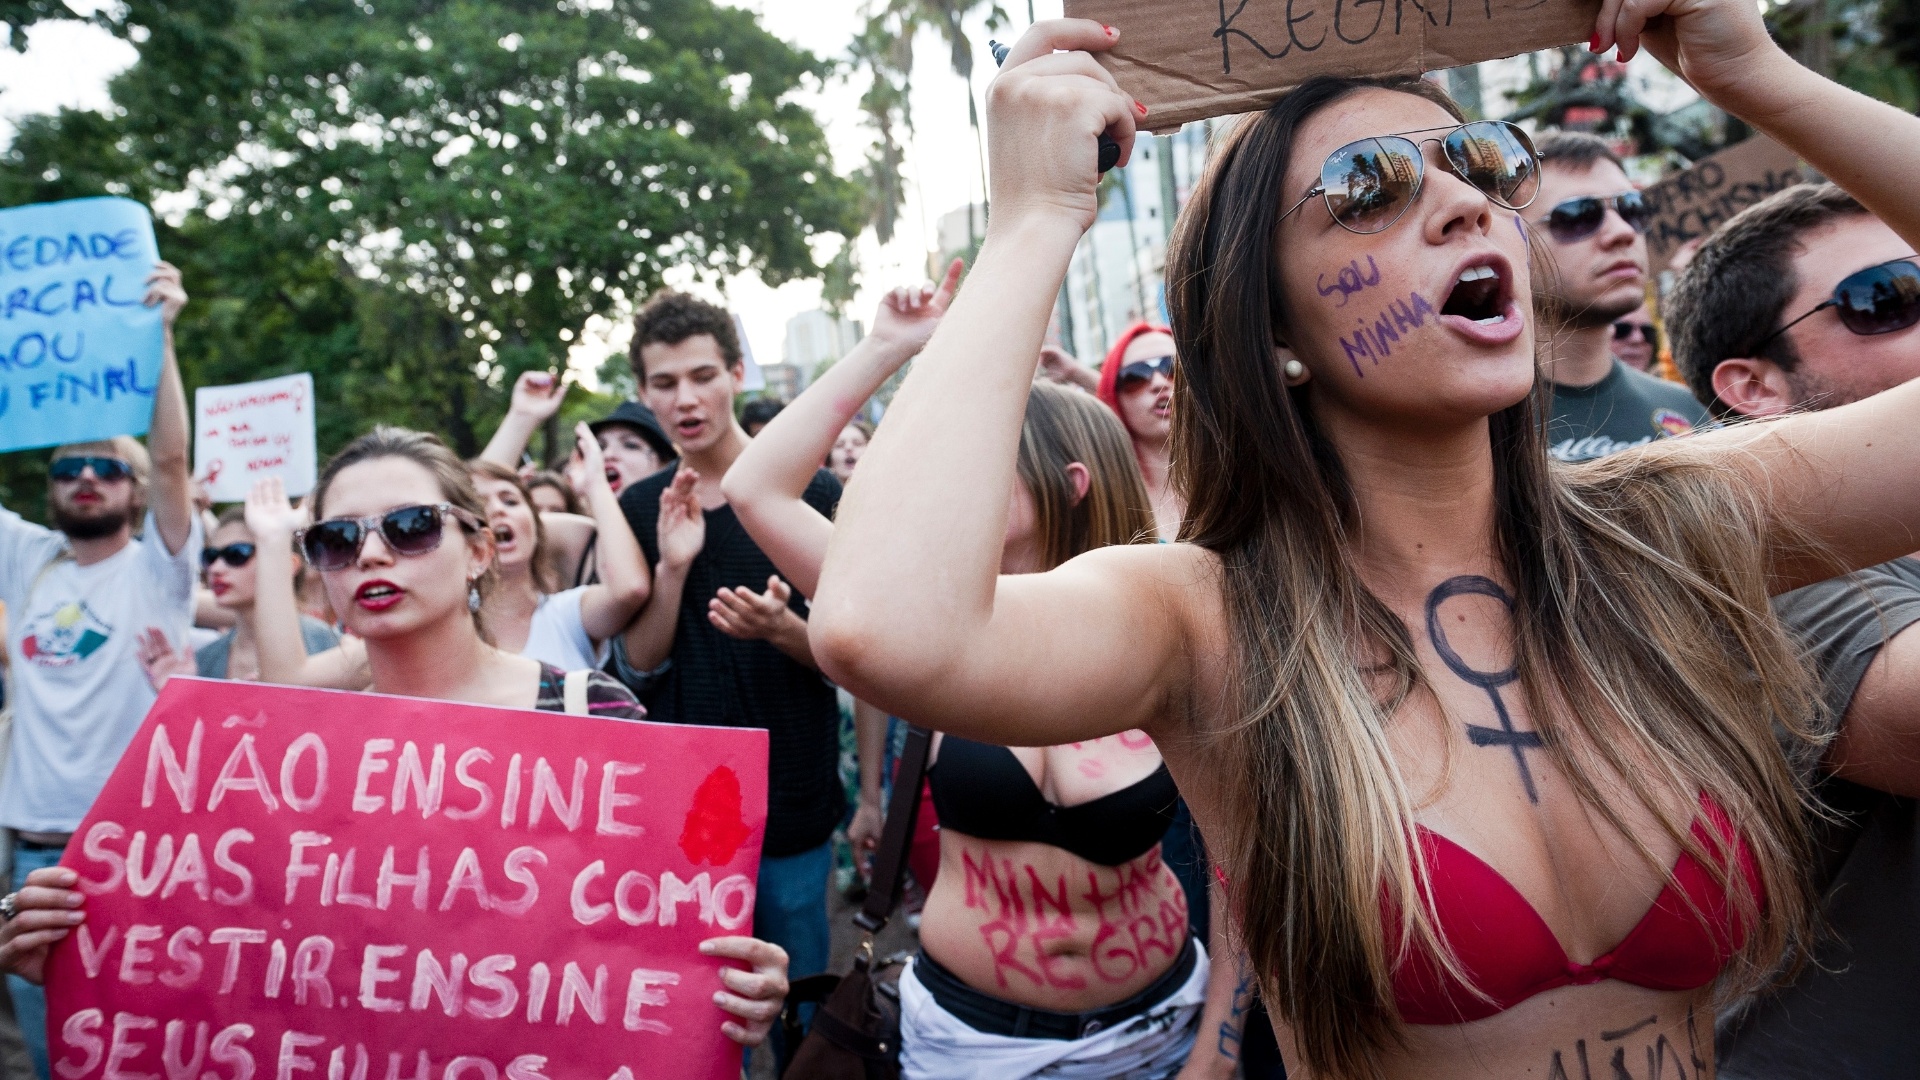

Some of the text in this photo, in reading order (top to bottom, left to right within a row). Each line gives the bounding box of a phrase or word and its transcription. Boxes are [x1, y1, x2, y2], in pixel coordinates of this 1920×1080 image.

[1213, 0, 1547, 75] REG
[0, 229, 143, 271] EDADE
[1316, 254, 1380, 308] SOU
[0, 274, 144, 319] RCAL
[1338, 291, 1440, 379] MINHA
[28, 358, 153, 410] FINAL
[141, 709, 646, 838] NÃO ENSINE
[80, 821, 752, 930] SUAS FILHAS COMO
[359, 944, 682, 1035] ENSINE
[55, 1008, 255, 1080] SEUS
